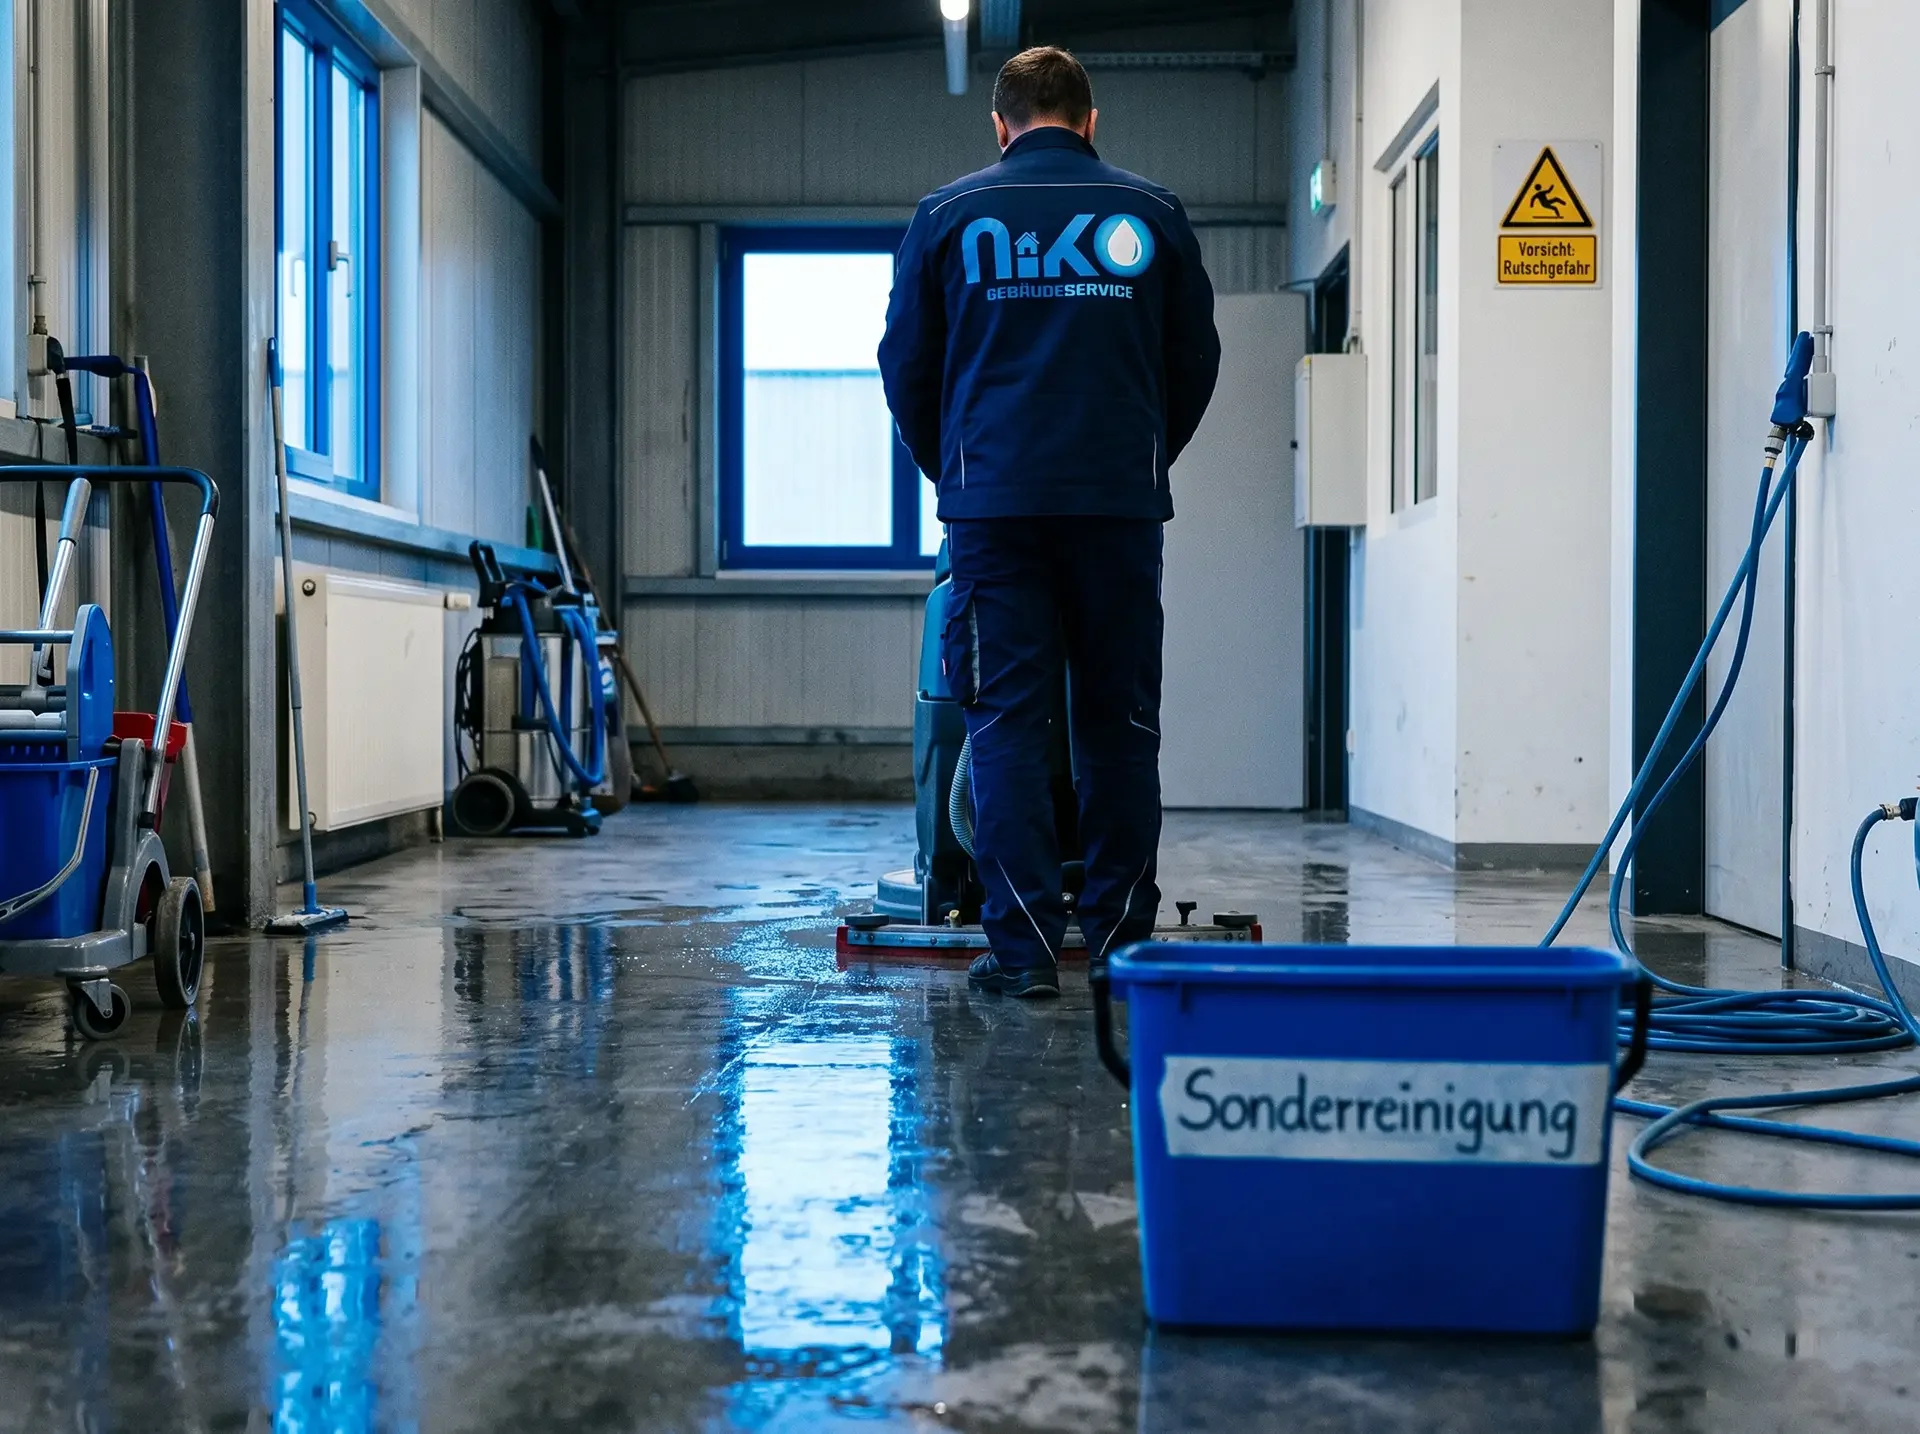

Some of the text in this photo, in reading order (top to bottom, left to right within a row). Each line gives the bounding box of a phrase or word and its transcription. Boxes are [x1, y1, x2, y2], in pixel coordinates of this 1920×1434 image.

[1503, 260, 1591, 279] Rutschgefahr
[987, 284, 1133, 301] GEBÄUDESERVICE
[1177, 1066, 1578, 1160] Sonderreinigung
